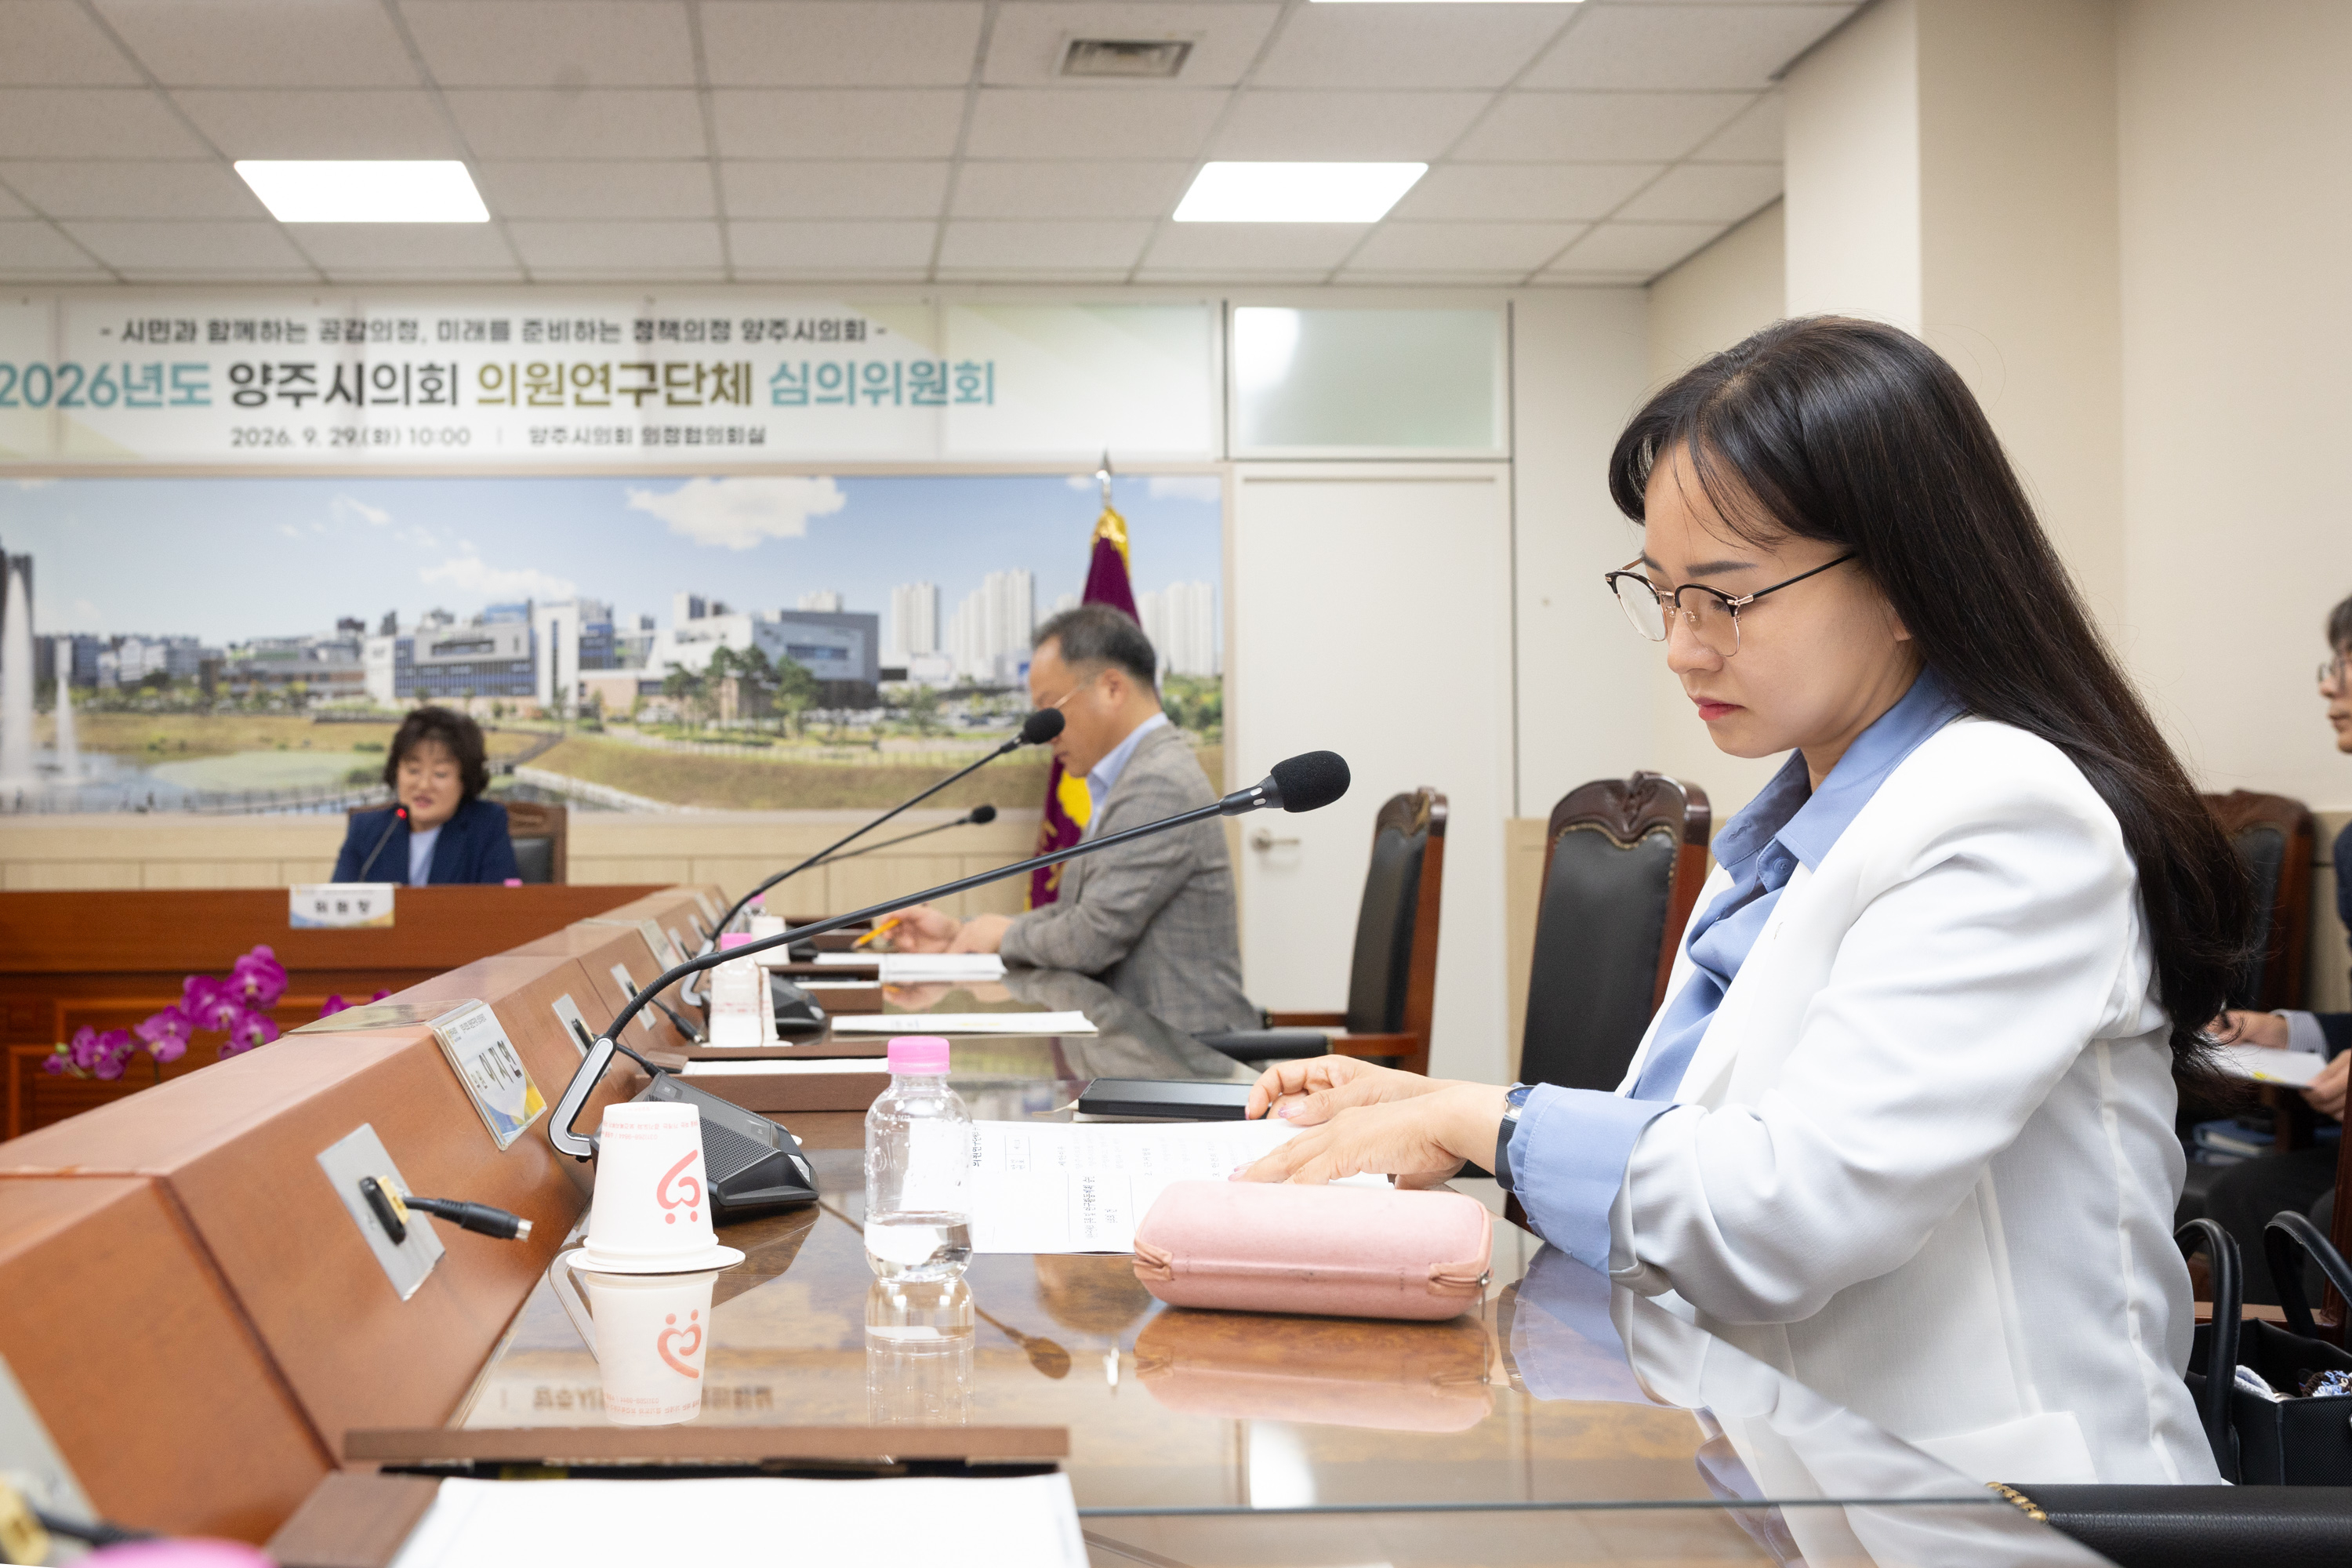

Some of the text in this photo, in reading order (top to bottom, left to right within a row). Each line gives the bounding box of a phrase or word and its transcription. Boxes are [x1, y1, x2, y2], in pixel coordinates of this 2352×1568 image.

[120, 318, 200, 345] 시민과
[206, 318, 309, 344] 함께하는
[437, 318, 511, 343] 미래를
[521, 318, 622, 344] 준비하는
[631, 318, 732, 345] 정책의정
[740, 318, 866, 344] 양주시의회
[0, 360, 995, 409] 2026년도 양주시의회 의원연구단체 심의위원회
